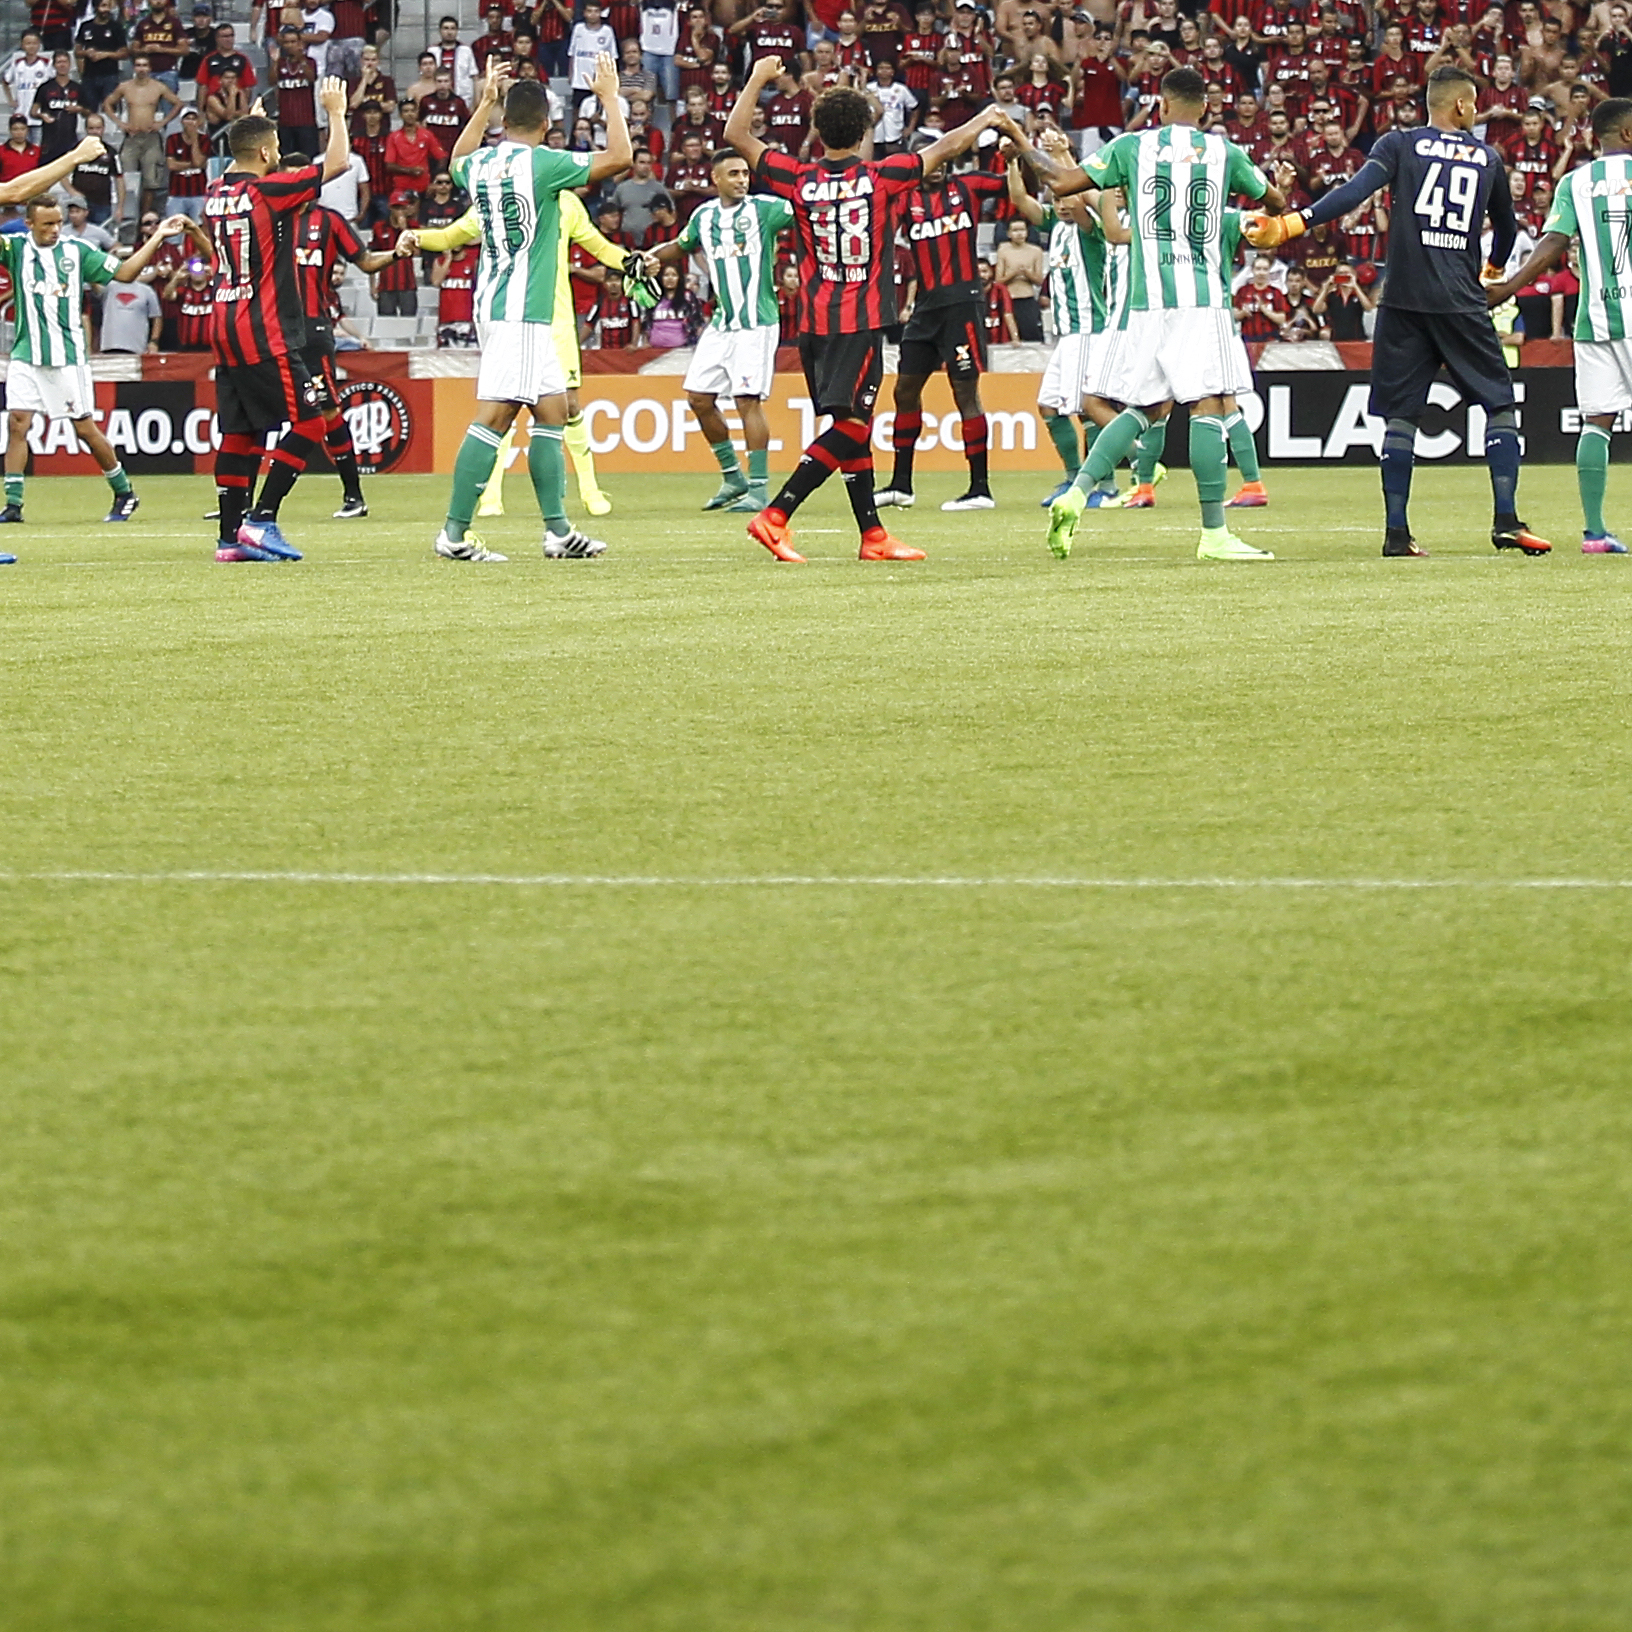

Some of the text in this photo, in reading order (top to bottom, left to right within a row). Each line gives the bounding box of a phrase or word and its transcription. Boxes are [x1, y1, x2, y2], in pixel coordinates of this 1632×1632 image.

[866, 22, 899, 32] CAIXA
[757, 37, 792, 47] CAIXA
[1411, 40, 1441, 53] Philco
[1145, 145, 1219, 165] CAIXA
[1414, 138, 1488, 167] CAIXA
[802, 174, 874, 203] CAIXA
[1413, 163, 1480, 232] 49
[205, 190, 255, 217] CAIXA
[1142, 175, 1219, 245] 28
[808, 199, 872, 266] 98
[908, 212, 972, 241] CAIXA
[1421, 230, 1468, 251] WARLESON
[1304, 256, 1338, 268] CAIXA
